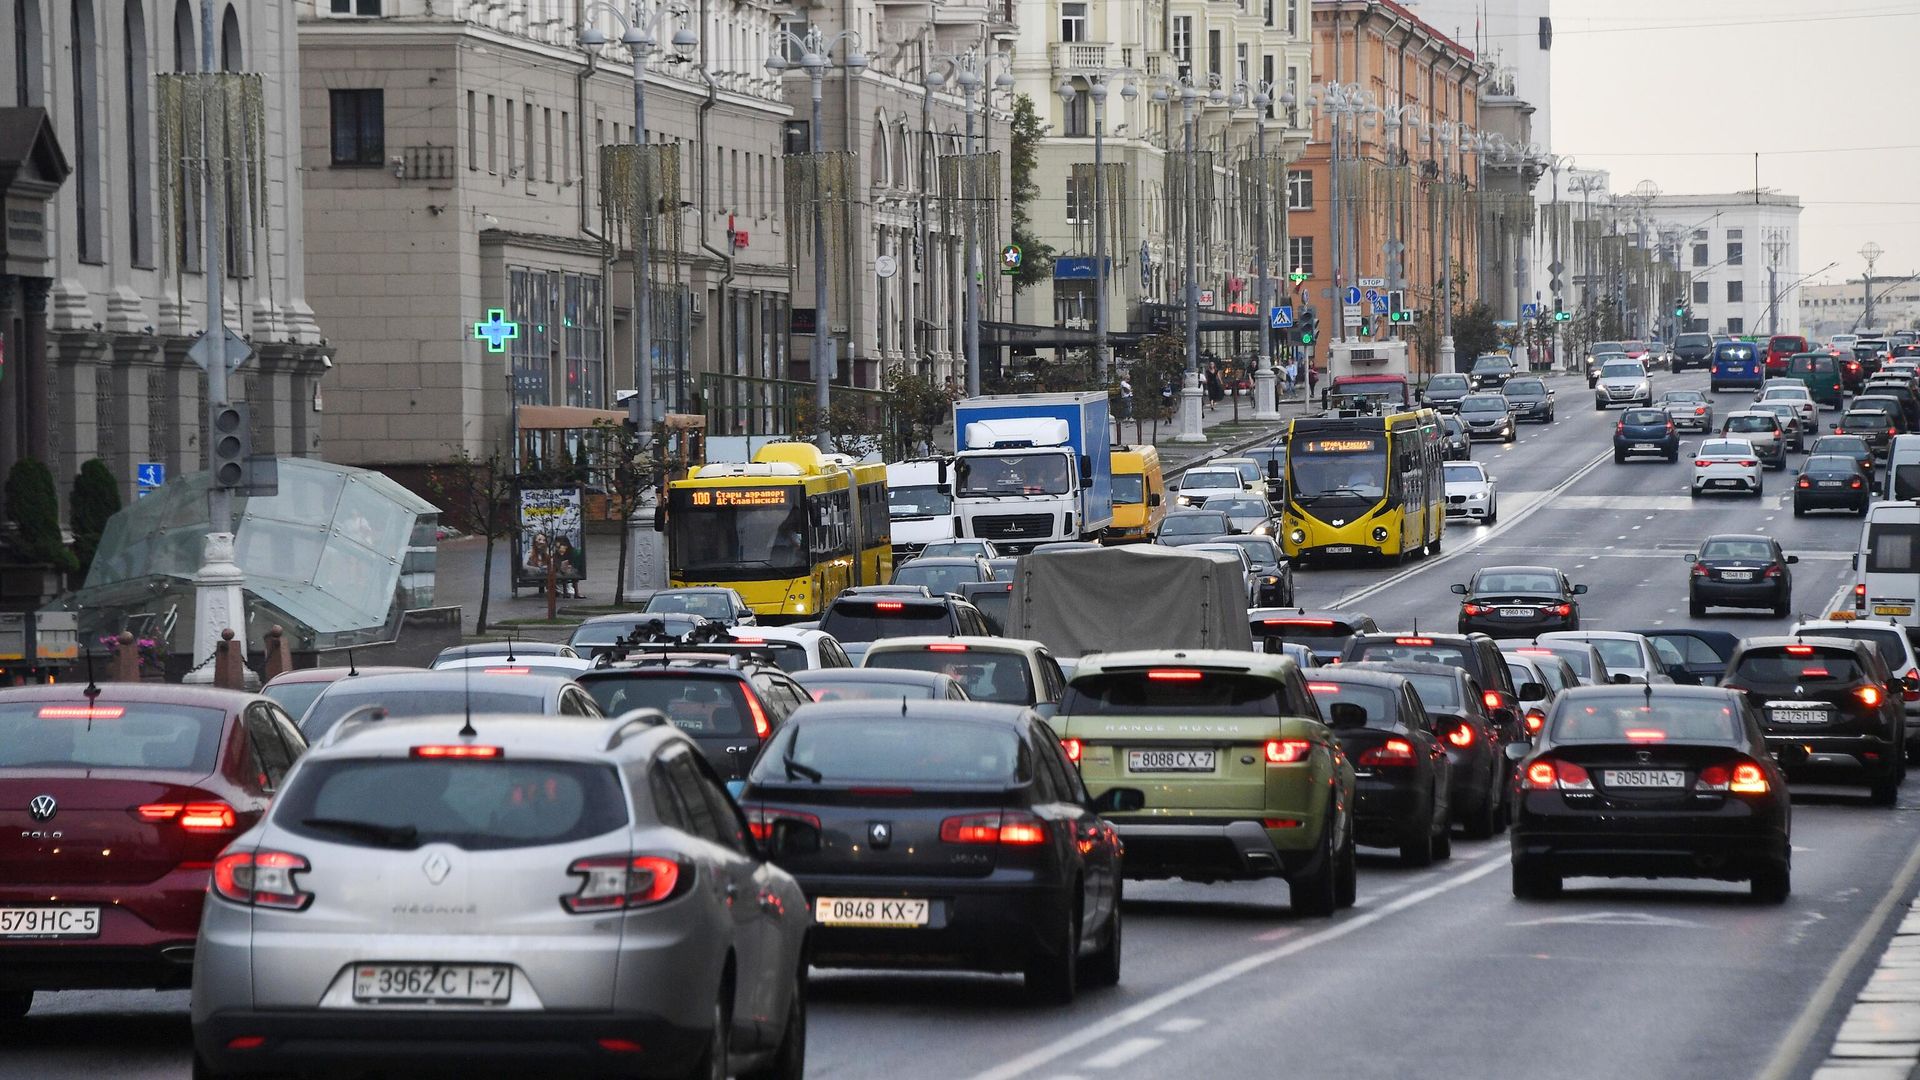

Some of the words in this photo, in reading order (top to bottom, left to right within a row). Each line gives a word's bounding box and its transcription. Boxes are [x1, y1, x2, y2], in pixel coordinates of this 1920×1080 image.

[716, 490, 742, 498] Стары
[744, 490, 785, 498] аэрапорт
[692, 491, 710, 506] 100
[716, 498, 728, 506] ДС
[1178, 724, 1239, 732] ROVER
[1616, 772, 1647, 785] 6050
[1650, 772, 1683, 786] HA-7
[21, 831, 62, 839] POLO
[833, 902, 875, 919] 0848
[881, 902, 924, 920] KX-7
